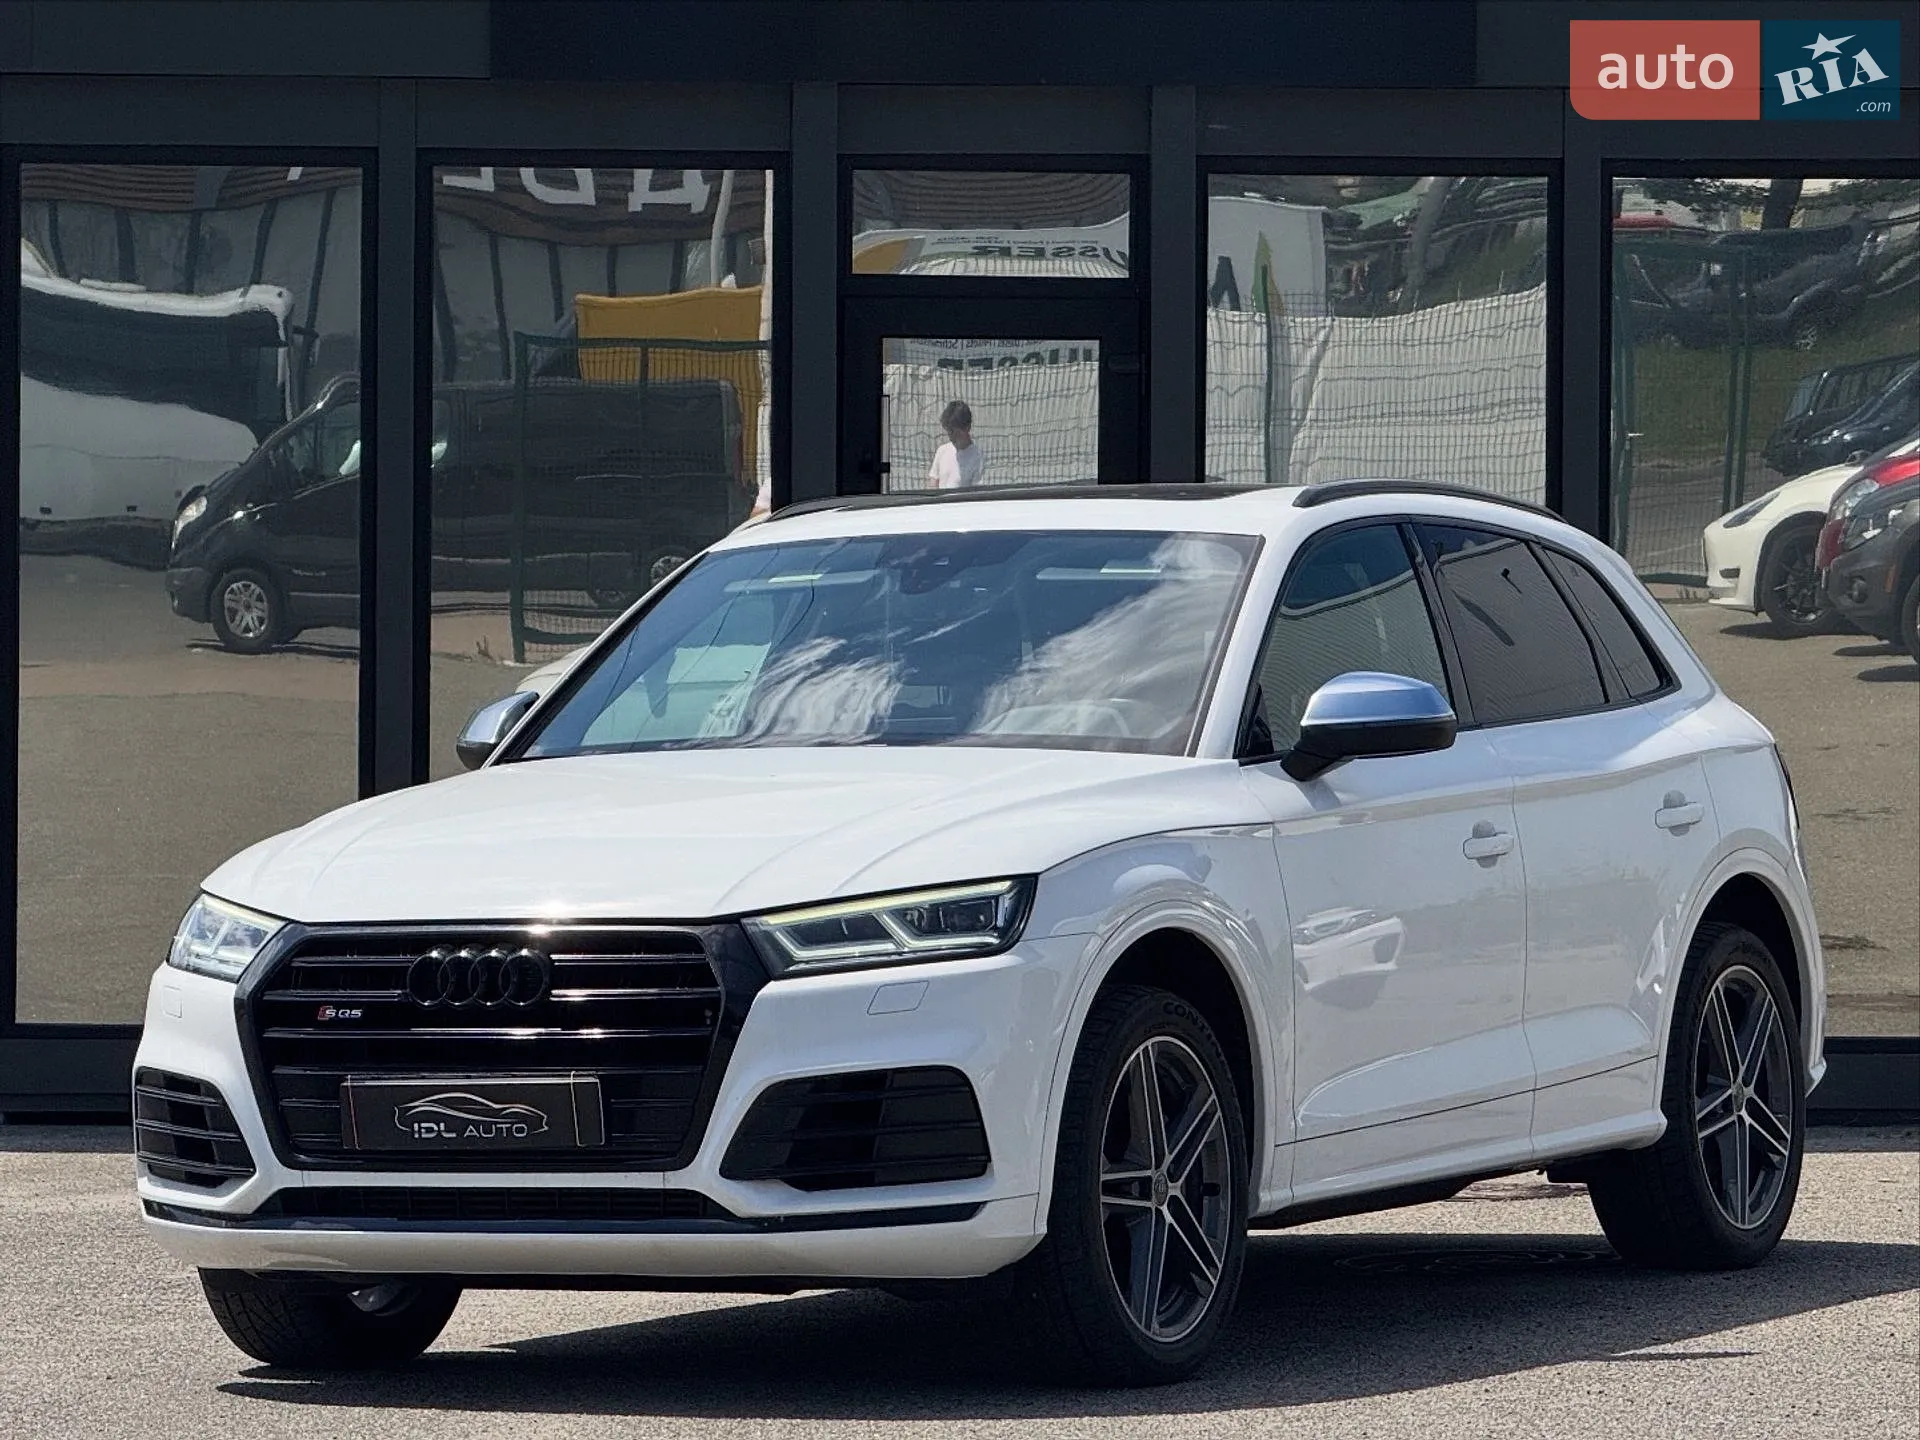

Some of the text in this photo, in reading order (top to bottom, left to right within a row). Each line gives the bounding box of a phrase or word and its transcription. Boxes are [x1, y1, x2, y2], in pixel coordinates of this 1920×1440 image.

[319, 1005, 363, 1020] SQ5
[413, 1122, 528, 1139] IDL AUTO
